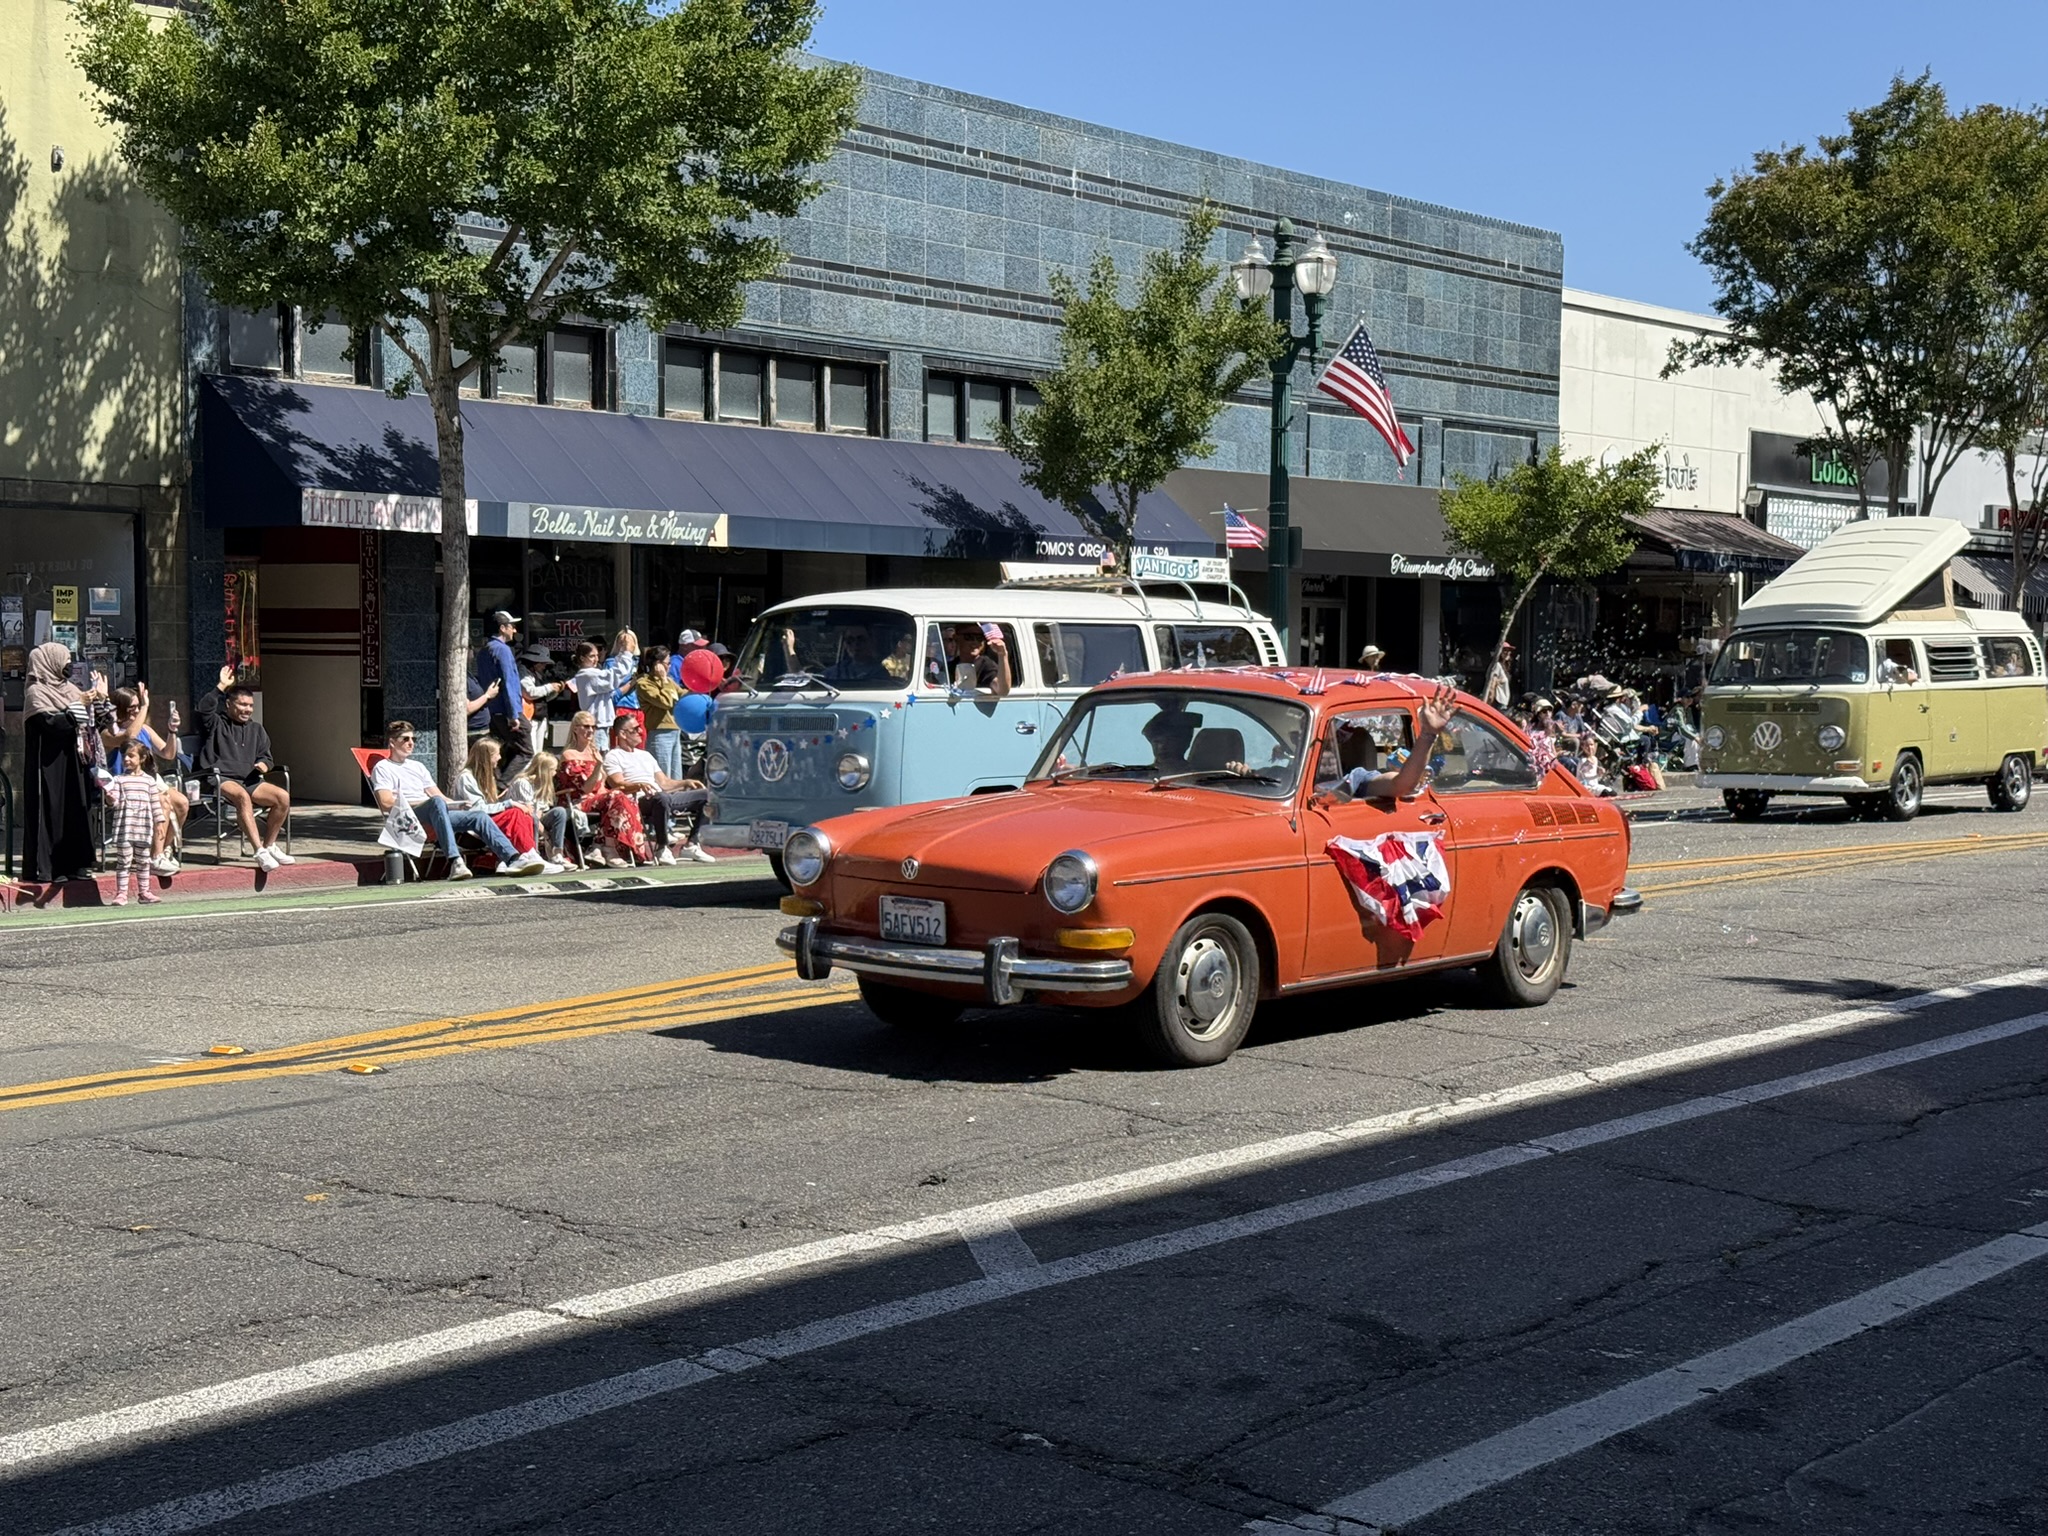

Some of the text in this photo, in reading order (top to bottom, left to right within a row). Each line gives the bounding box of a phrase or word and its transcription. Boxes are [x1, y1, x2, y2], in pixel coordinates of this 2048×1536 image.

[309, 495, 364, 526] LITTLE
[532, 507, 708, 546] Bella Nail Spa & Waxing
[365, 529, 375, 591] RTUNE
[1035, 540, 1075, 557] TOMO'S
[1078, 542, 1107, 558] ORGA
[1153, 546, 1170, 556] SPA
[1136, 557, 1199, 578] VANTIGO SF
[1390, 553, 1445, 578] Triumphant
[1444, 557, 1463, 580] Life
[56, 589, 74, 597] IMP
[555, 619, 584, 637] TK
[366, 614, 376, 677] TELLER
[1754, 721, 1782, 750] VW
[901, 858, 919, 880] VW
[884, 911, 942, 938] 5AFV512
